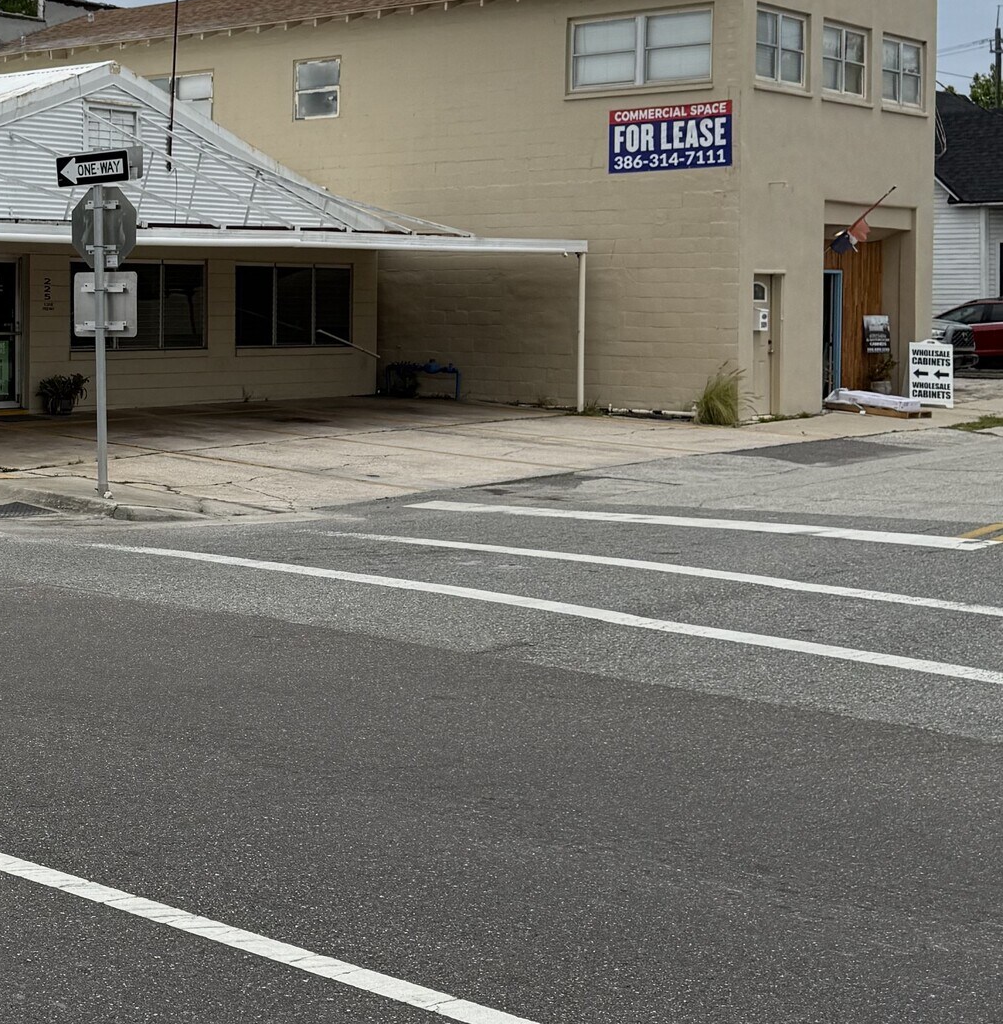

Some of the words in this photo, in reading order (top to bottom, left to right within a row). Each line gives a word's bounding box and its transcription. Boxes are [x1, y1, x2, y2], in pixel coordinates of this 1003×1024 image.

[614, 106, 687, 122] COMMERCIAL
[690, 102, 727, 116] SPACE
[614, 123, 655, 153] FOR
[660, 117, 727, 150] LEASE
[613, 149, 726, 170] 386-314-7111
[77, 163, 96, 177] ONE
[100, 160, 120, 174] WAY
[912, 349, 950, 357] WHOLESALE
[912, 357, 951, 366] CABINETS
[912, 382, 951, 390] WHOLESALE
[912, 390, 951, 399] CABINETS
